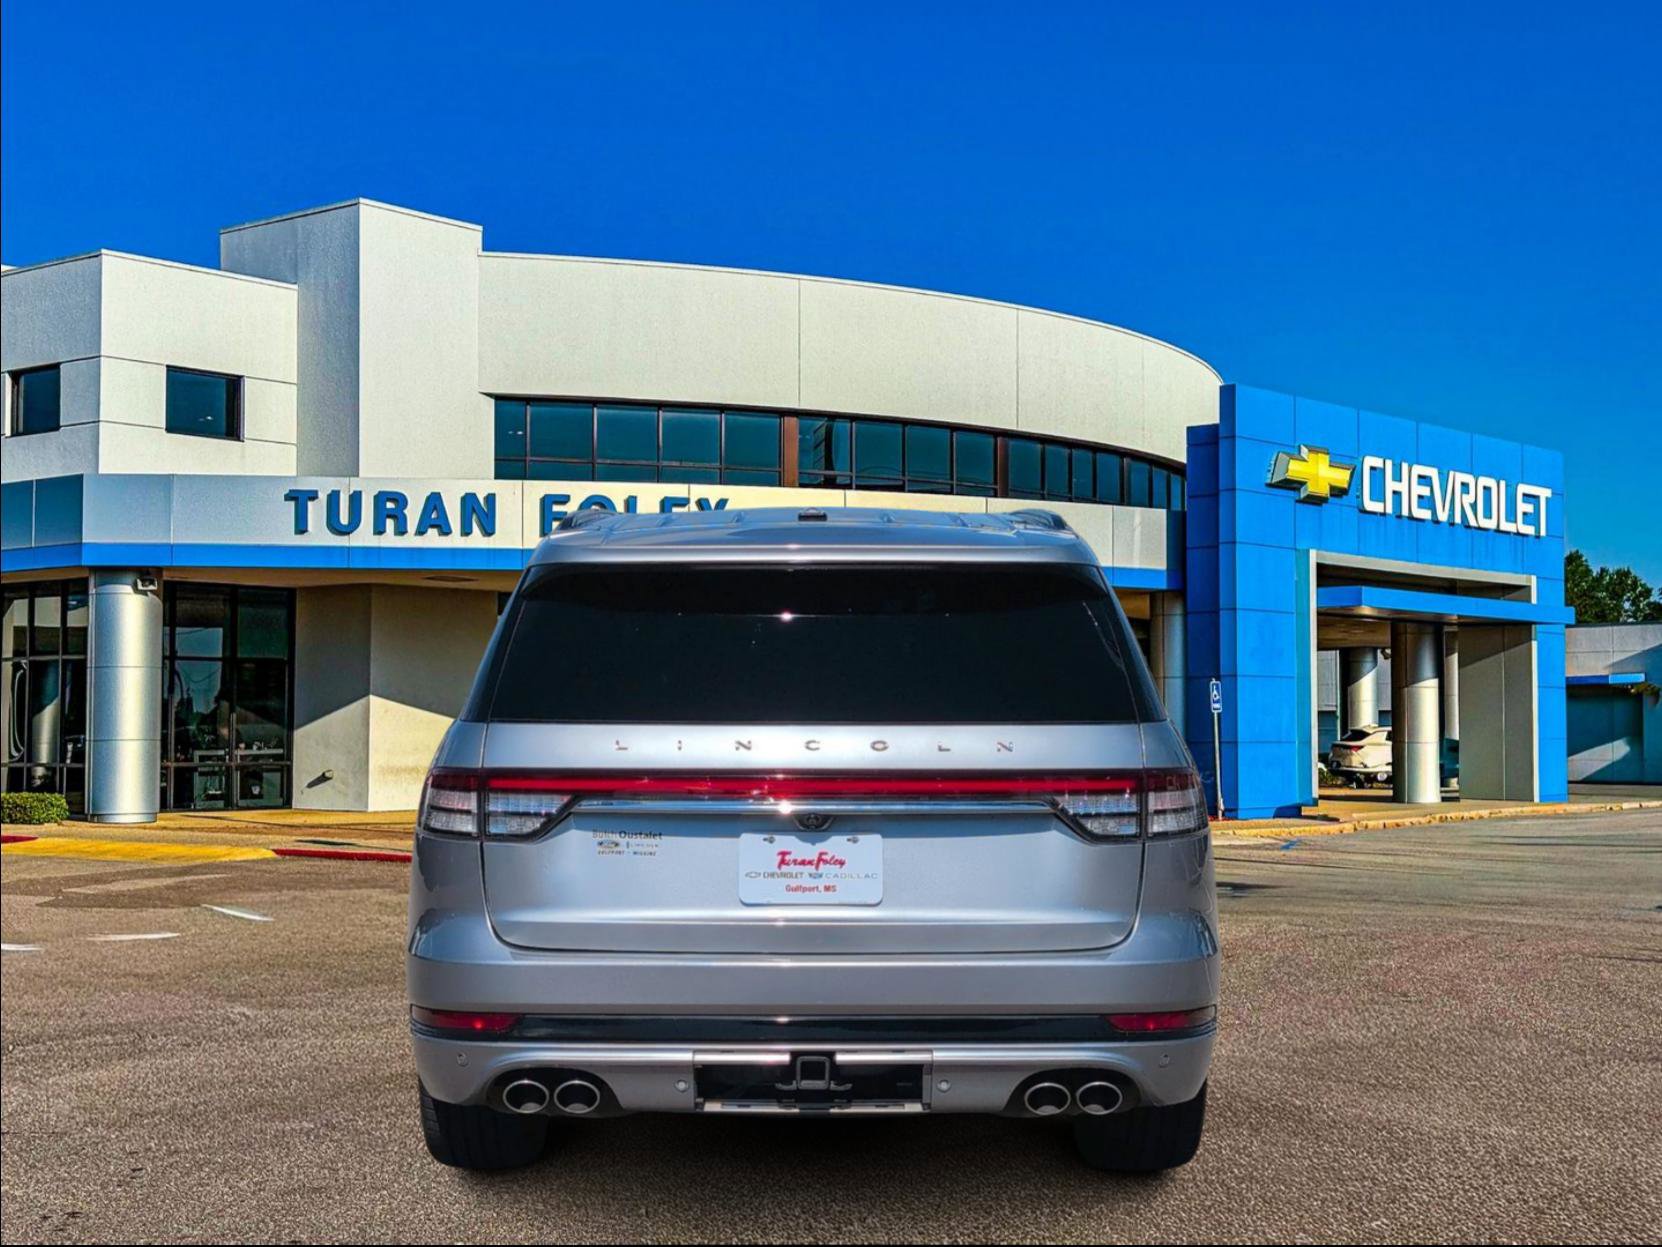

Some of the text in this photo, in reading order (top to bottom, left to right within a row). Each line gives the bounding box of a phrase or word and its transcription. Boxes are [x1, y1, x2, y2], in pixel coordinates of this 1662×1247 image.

[1362, 455, 1552, 537] CHEVROLET
[284, 488, 496, 537] TURAN
[615, 739, 1014, 753] LINCOLN
[618, 830, 663, 840] Oustalet
[763, 871, 878, 880] CHEVROLET CADILLAC
[785, 884, 837, 893] Gulfport, MS
